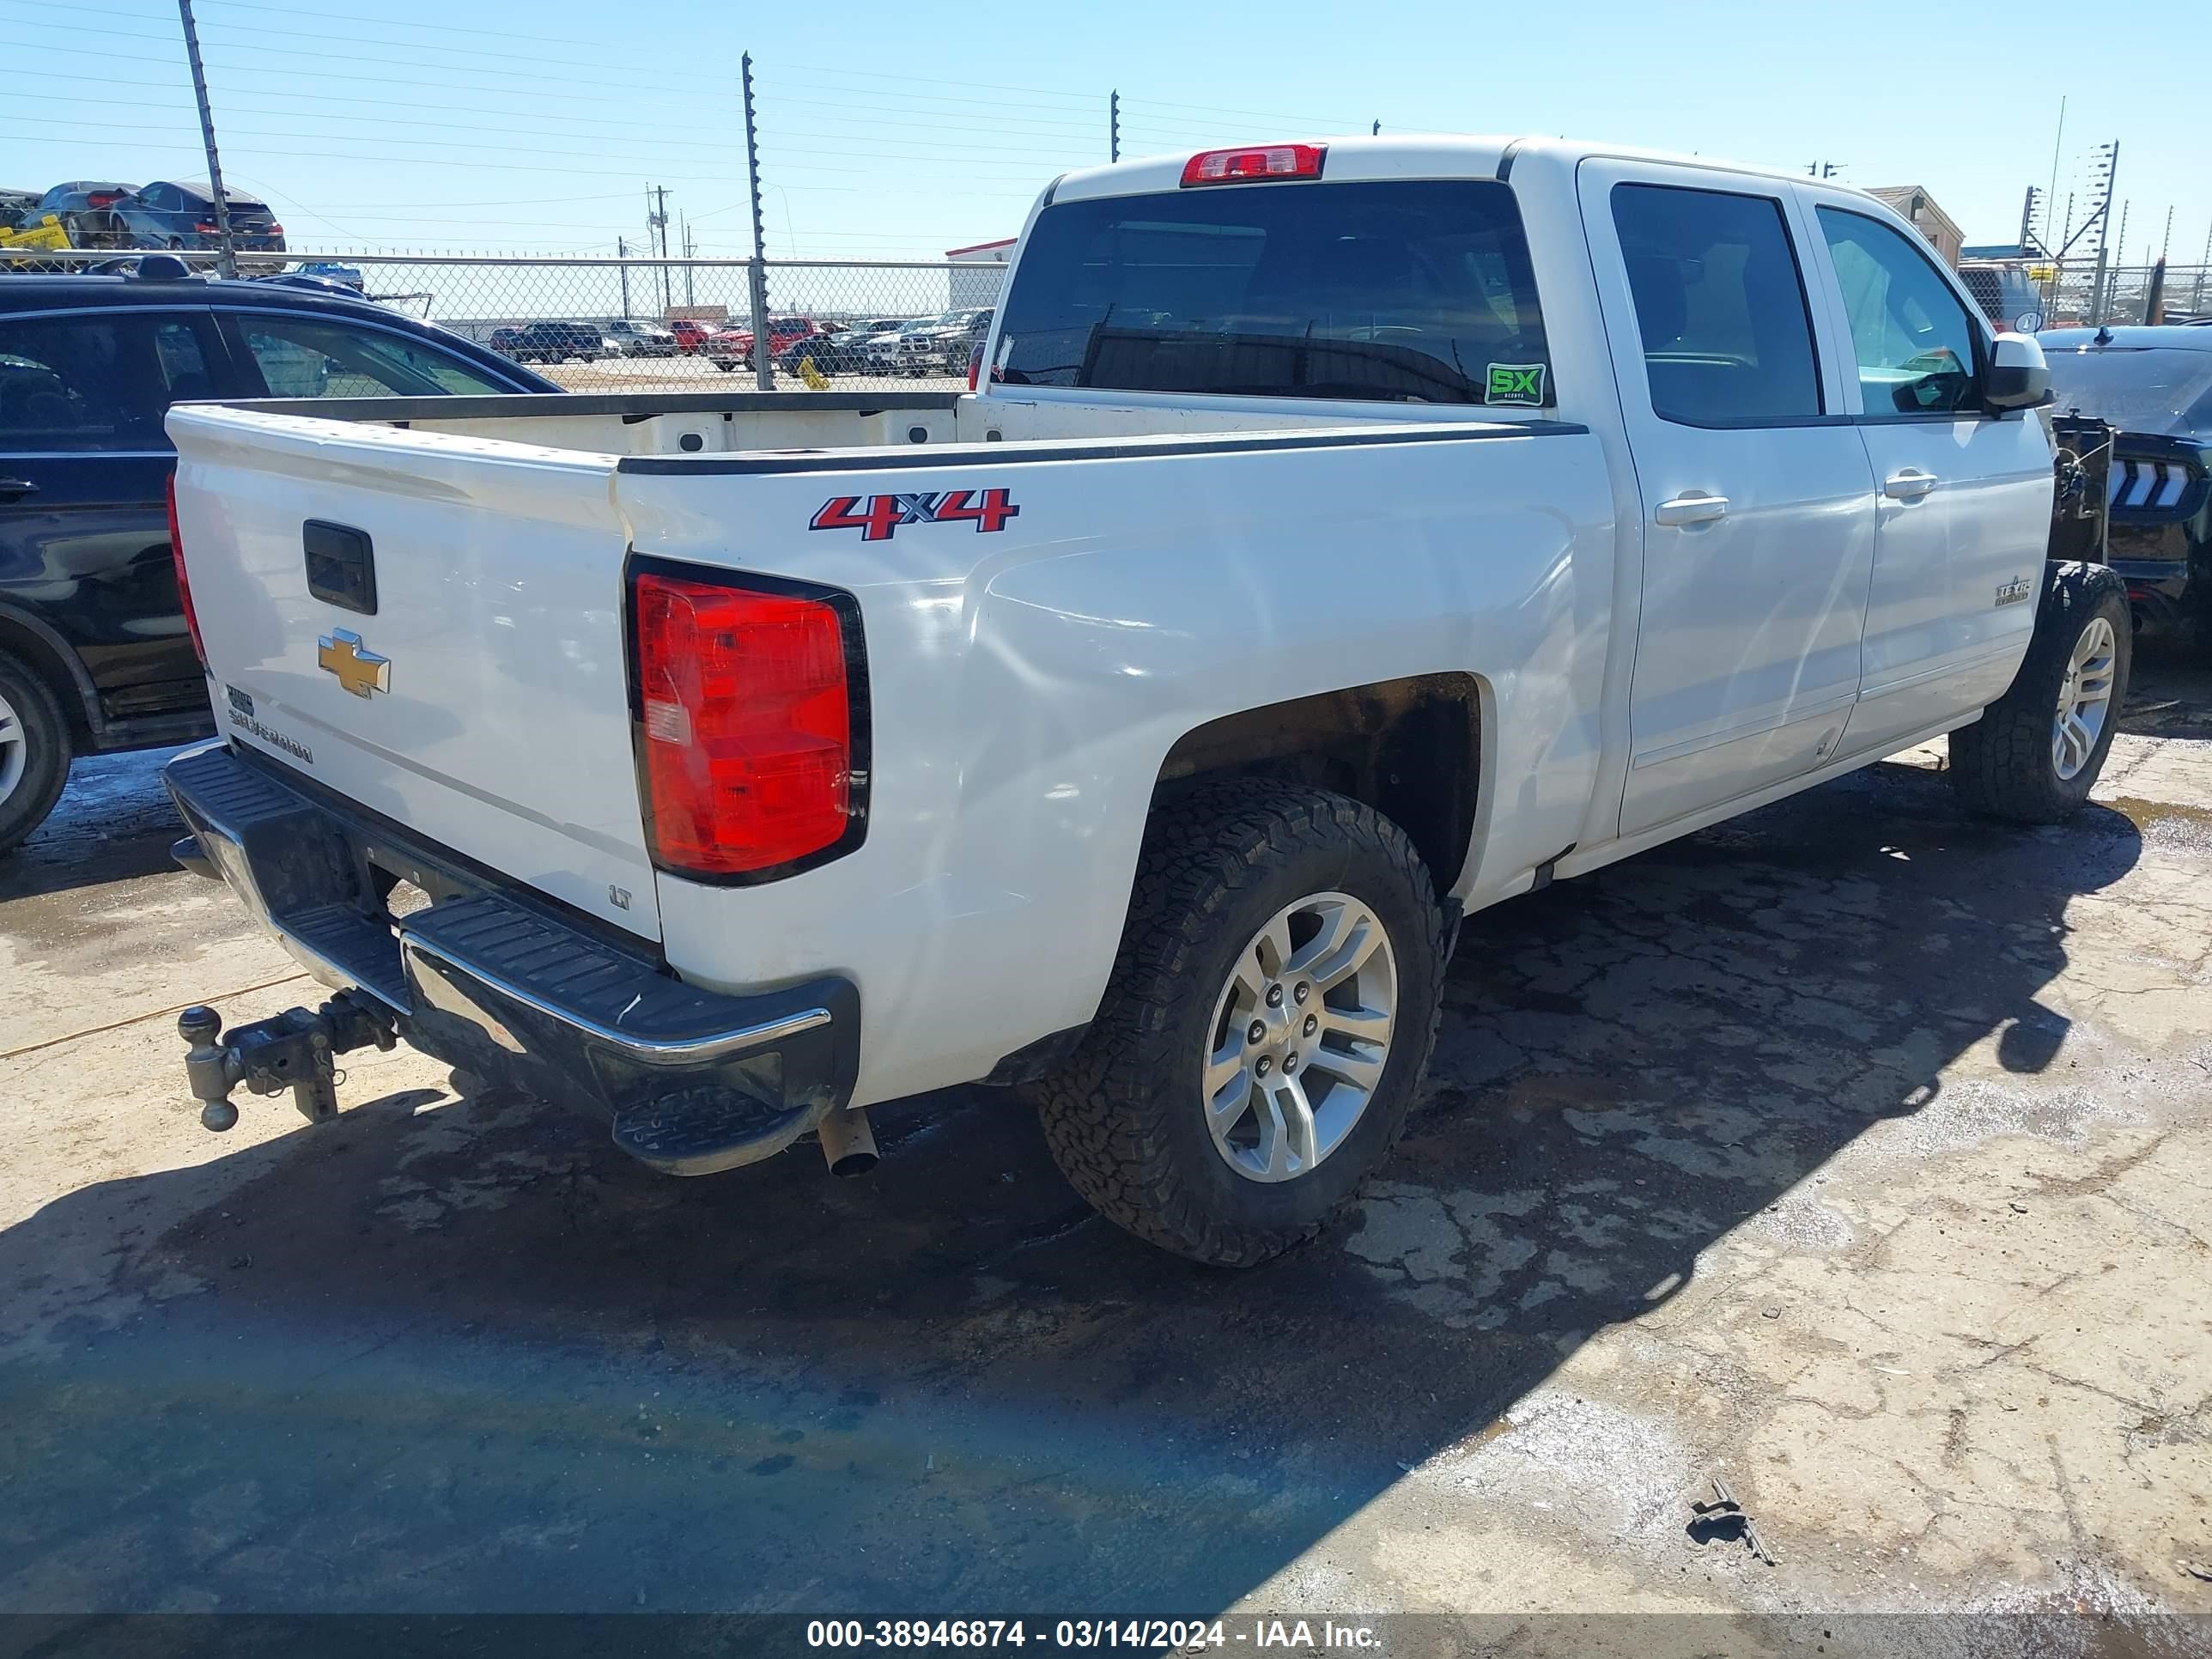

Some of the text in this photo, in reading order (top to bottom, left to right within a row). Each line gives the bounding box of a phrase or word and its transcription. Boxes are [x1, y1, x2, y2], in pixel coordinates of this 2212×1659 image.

[1492, 370, 1540, 395] SX
[228, 708, 313, 763] SILVERADO
[609, 884, 632, 910] LT
